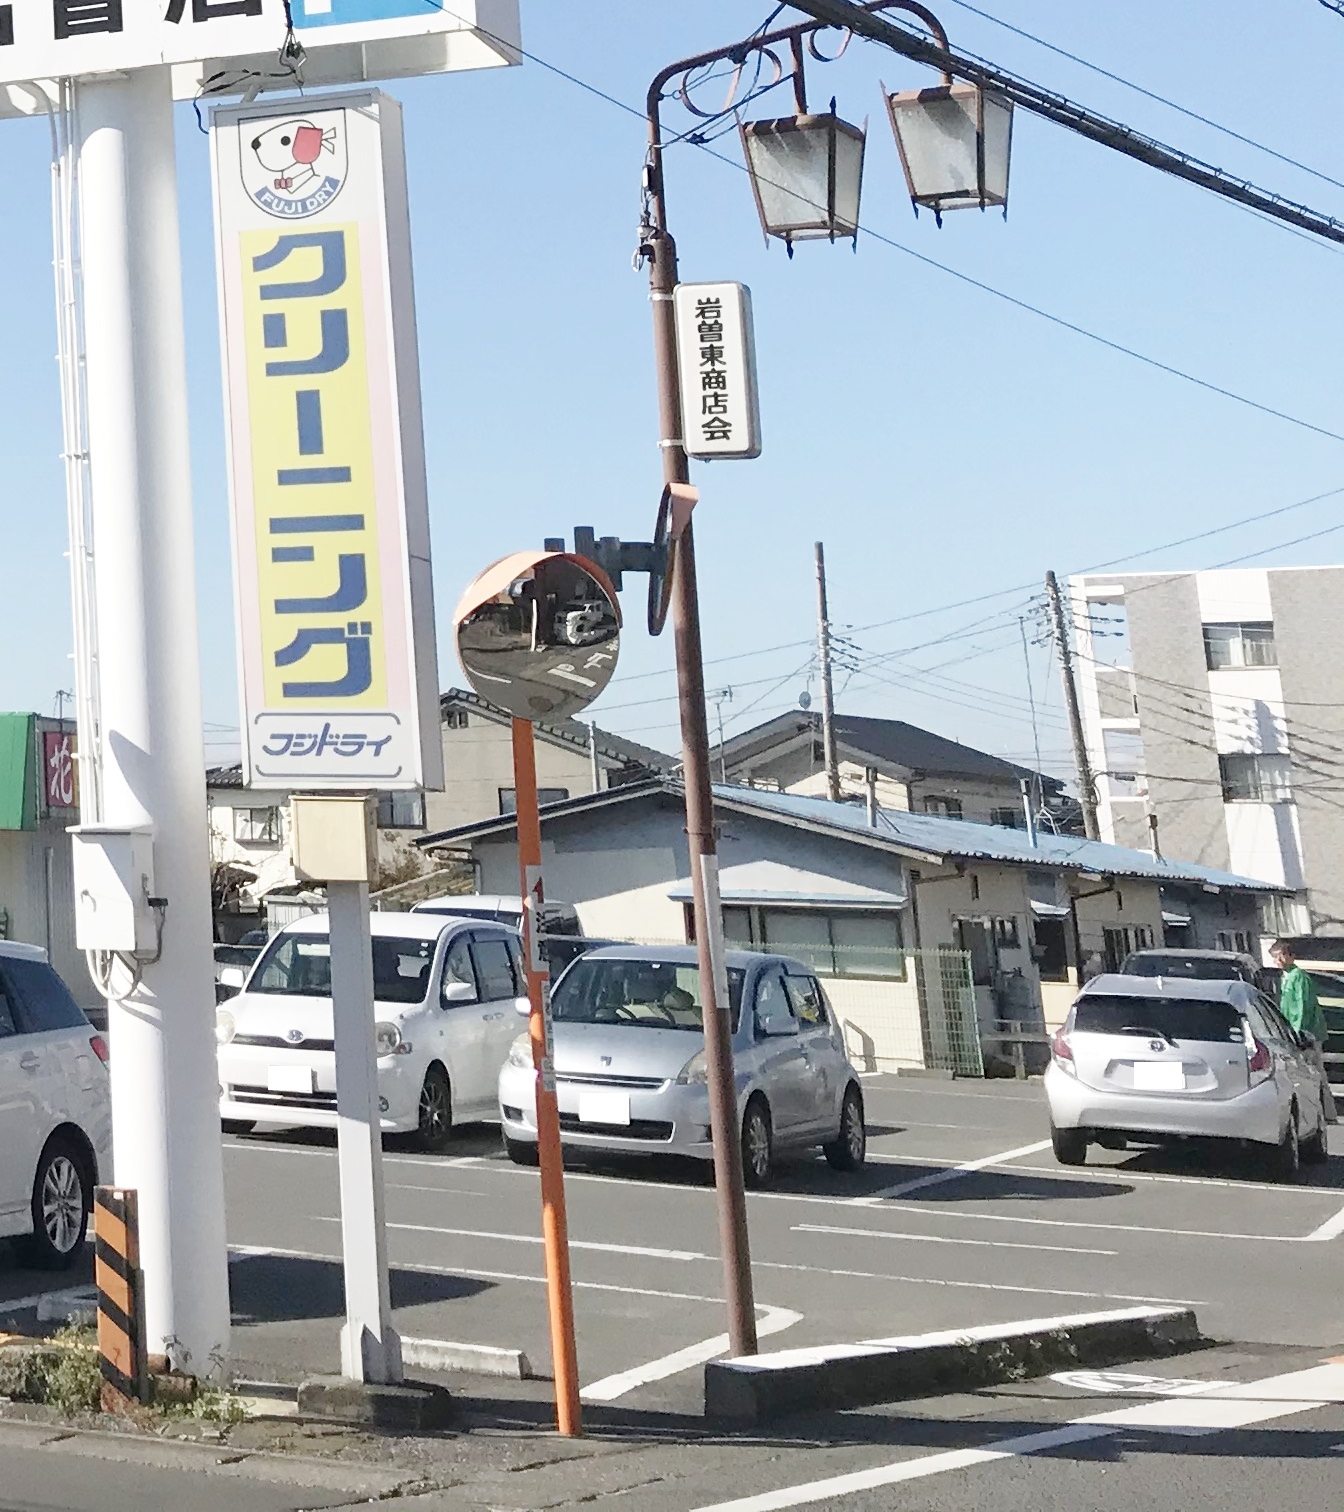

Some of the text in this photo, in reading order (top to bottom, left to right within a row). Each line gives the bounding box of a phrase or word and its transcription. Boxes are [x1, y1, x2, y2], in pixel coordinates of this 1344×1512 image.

[259, 181, 335, 214] FUJI DRY
[695, 297, 733, 441] 岩曽東商店会
[251, 230, 373, 698] クリーニング
[49, 735, 73, 805] 花
[261, 721, 393, 758] フジドライ
